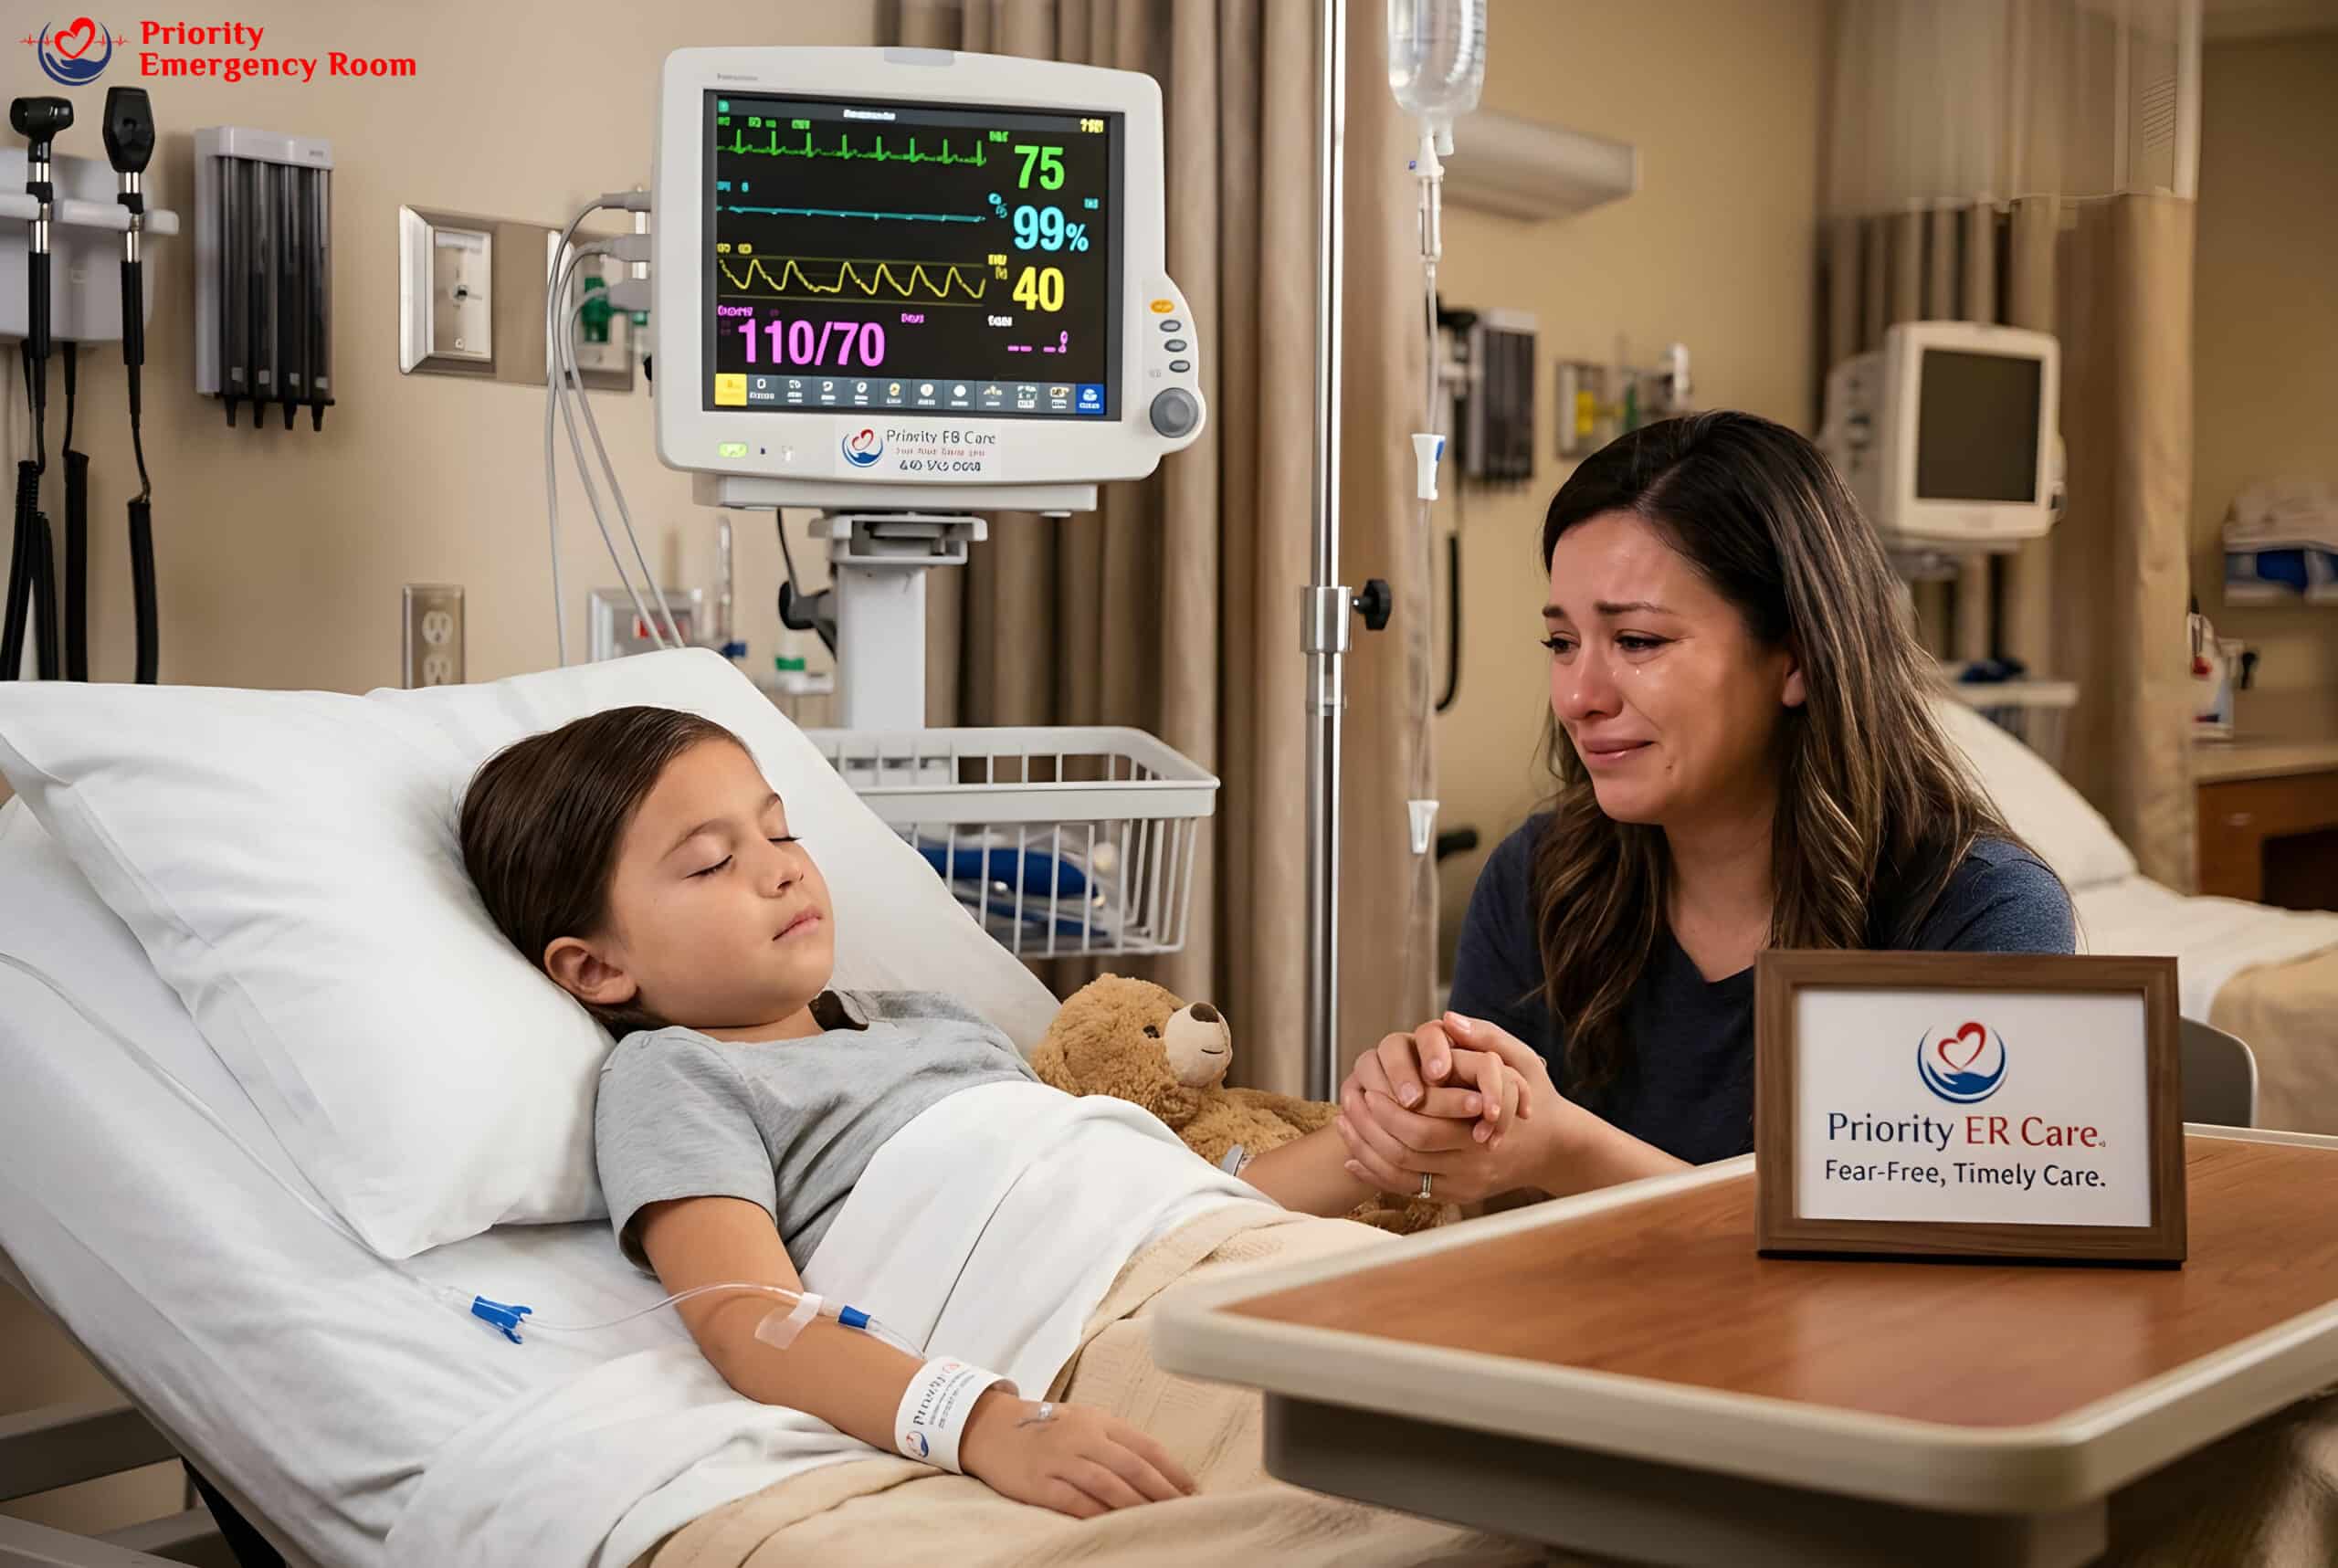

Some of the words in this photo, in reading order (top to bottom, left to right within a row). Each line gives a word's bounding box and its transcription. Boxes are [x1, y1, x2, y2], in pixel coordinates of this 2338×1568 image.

[1015, 145, 1064, 190] 75
[1014, 205, 1089, 251] 99%
[1013, 267, 1064, 311] 40
[739, 319, 884, 366] 110/70
[1829, 1113, 1954, 1152] Priority
[1965, 1116, 2009, 1145] ER
[1827, 1160, 1945, 1187] Fear-Free,
[1954, 1163, 2036, 1191] Timely
[2044, 1164, 2105, 1186] Care.
